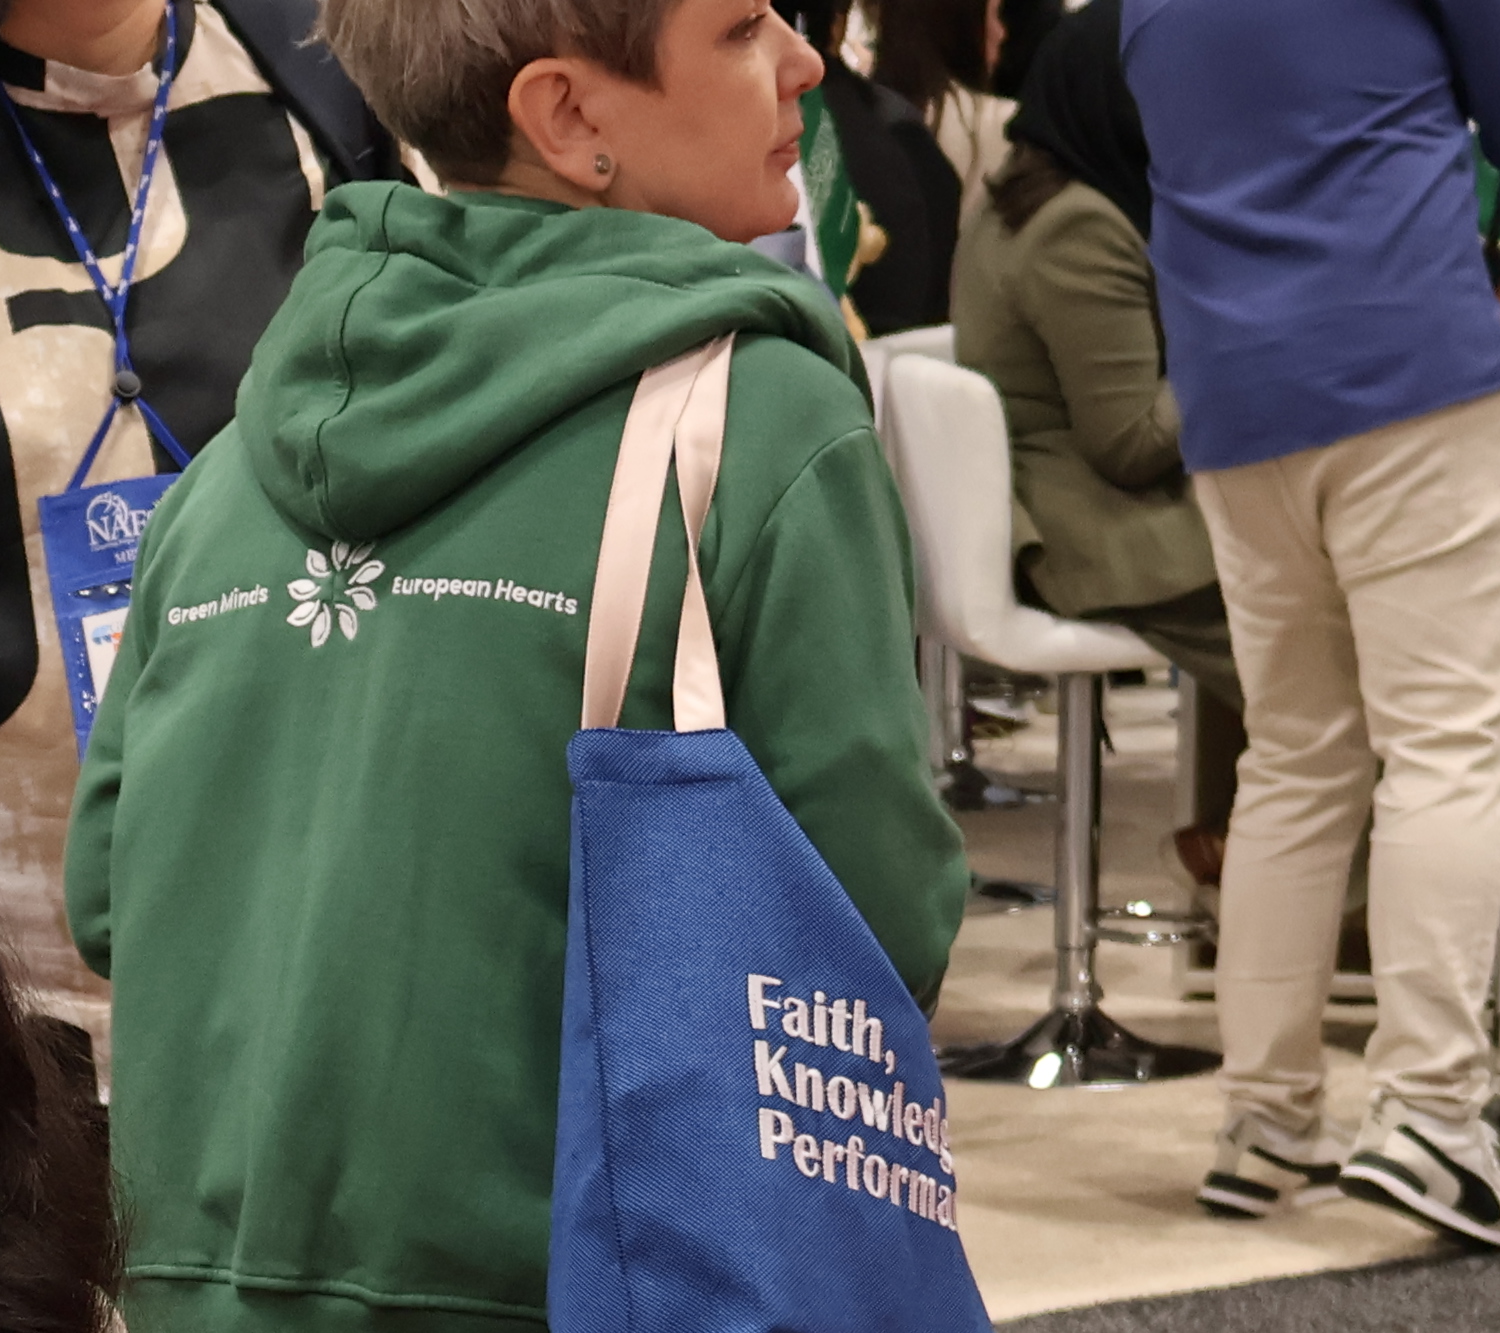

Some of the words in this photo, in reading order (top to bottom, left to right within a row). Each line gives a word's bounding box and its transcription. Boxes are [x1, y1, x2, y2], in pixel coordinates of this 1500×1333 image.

[167, 599, 217, 625] Green
[221, 584, 269, 614] Minds
[392, 576, 490, 600] European
[494, 579, 578, 615] Hearts
[748, 973, 896, 1076] Faith,
[754, 1039, 953, 1175] Knowledg
[758, 1107, 957, 1232] Performa
